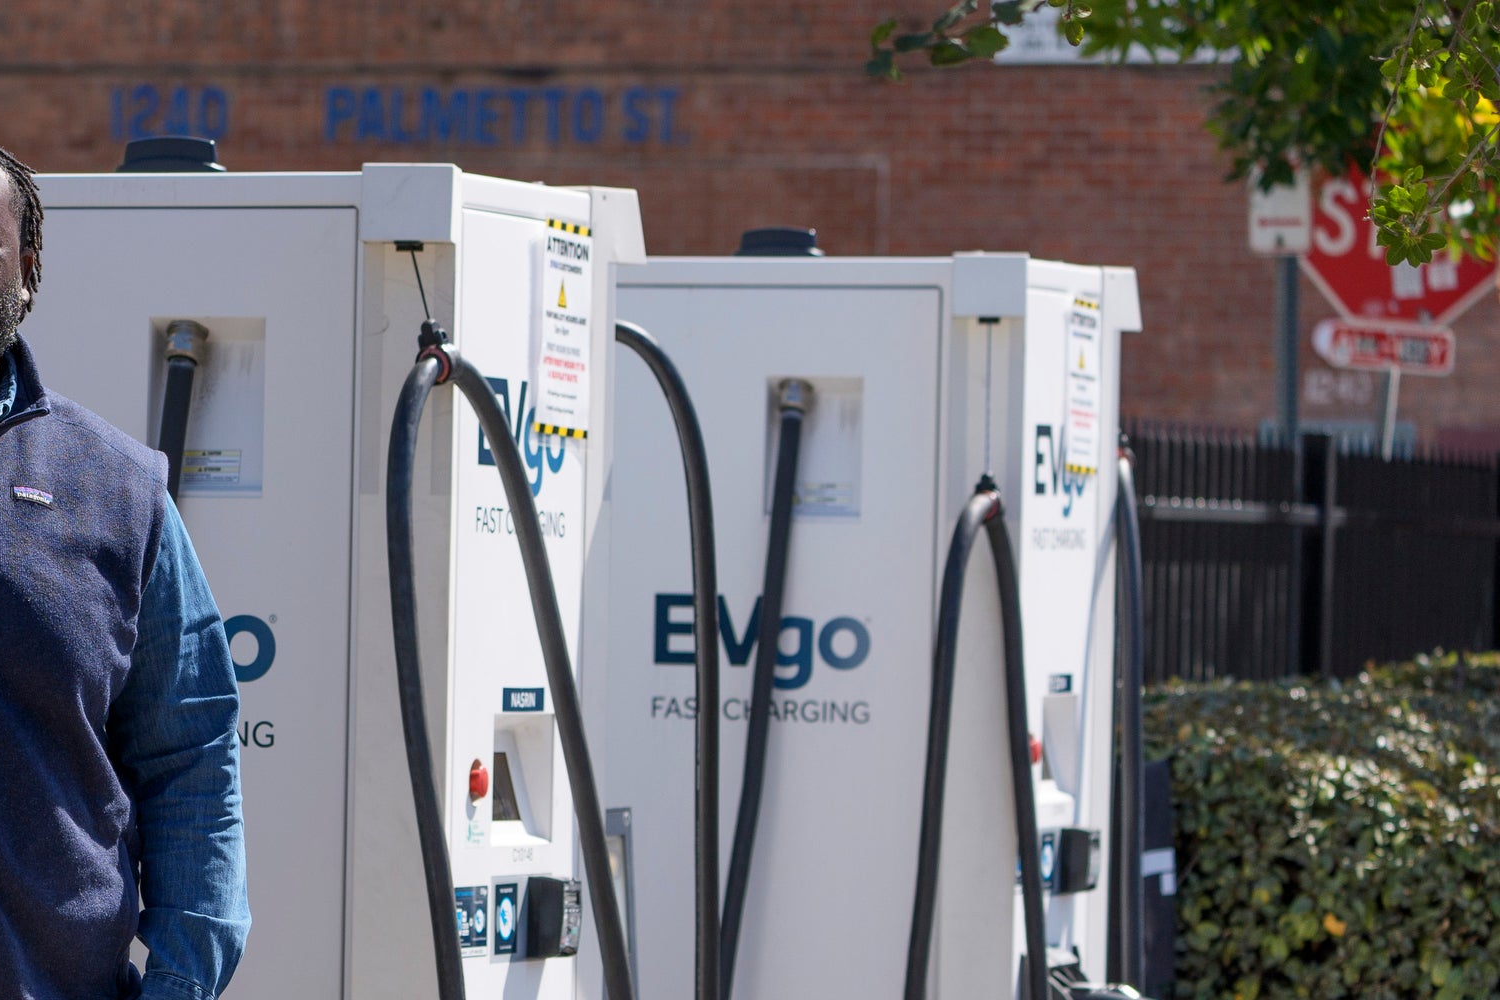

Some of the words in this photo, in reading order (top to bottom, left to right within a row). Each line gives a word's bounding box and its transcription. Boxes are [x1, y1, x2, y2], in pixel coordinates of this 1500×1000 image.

[324, 85, 605, 145] PALMETTO
[547, 236, 589, 262] ATTENTION
[475, 506, 503, 535] FAST
[505, 510, 566, 539] CGING
[654, 593, 871, 691] EVgo
[510, 691, 537, 709] NASRIN
[651, 697, 700, 720] FAS
